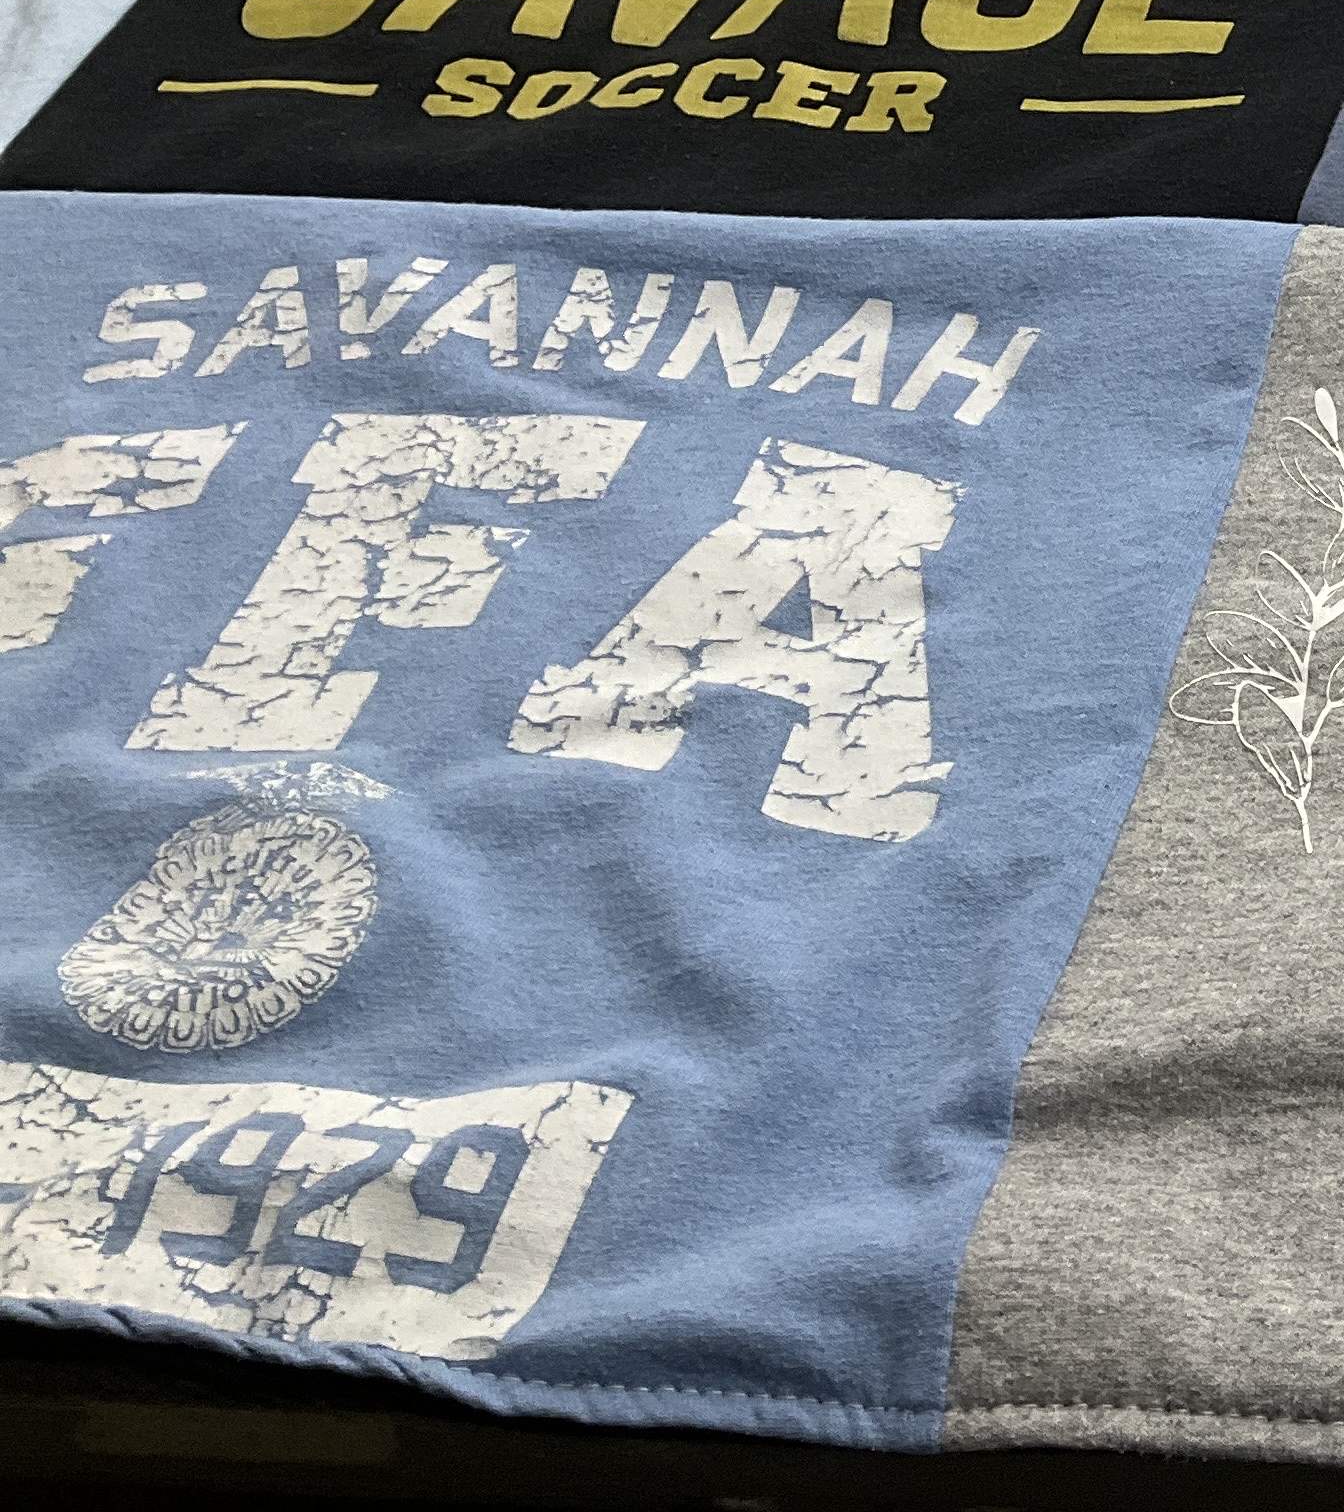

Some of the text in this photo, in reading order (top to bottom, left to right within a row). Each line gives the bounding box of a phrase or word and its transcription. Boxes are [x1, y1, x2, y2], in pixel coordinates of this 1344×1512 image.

[421, 55, 949, 134] SOCCER
[82, 256, 1042, 426] SAVANNAH
[97, 1110, 532, 1295] 1929
